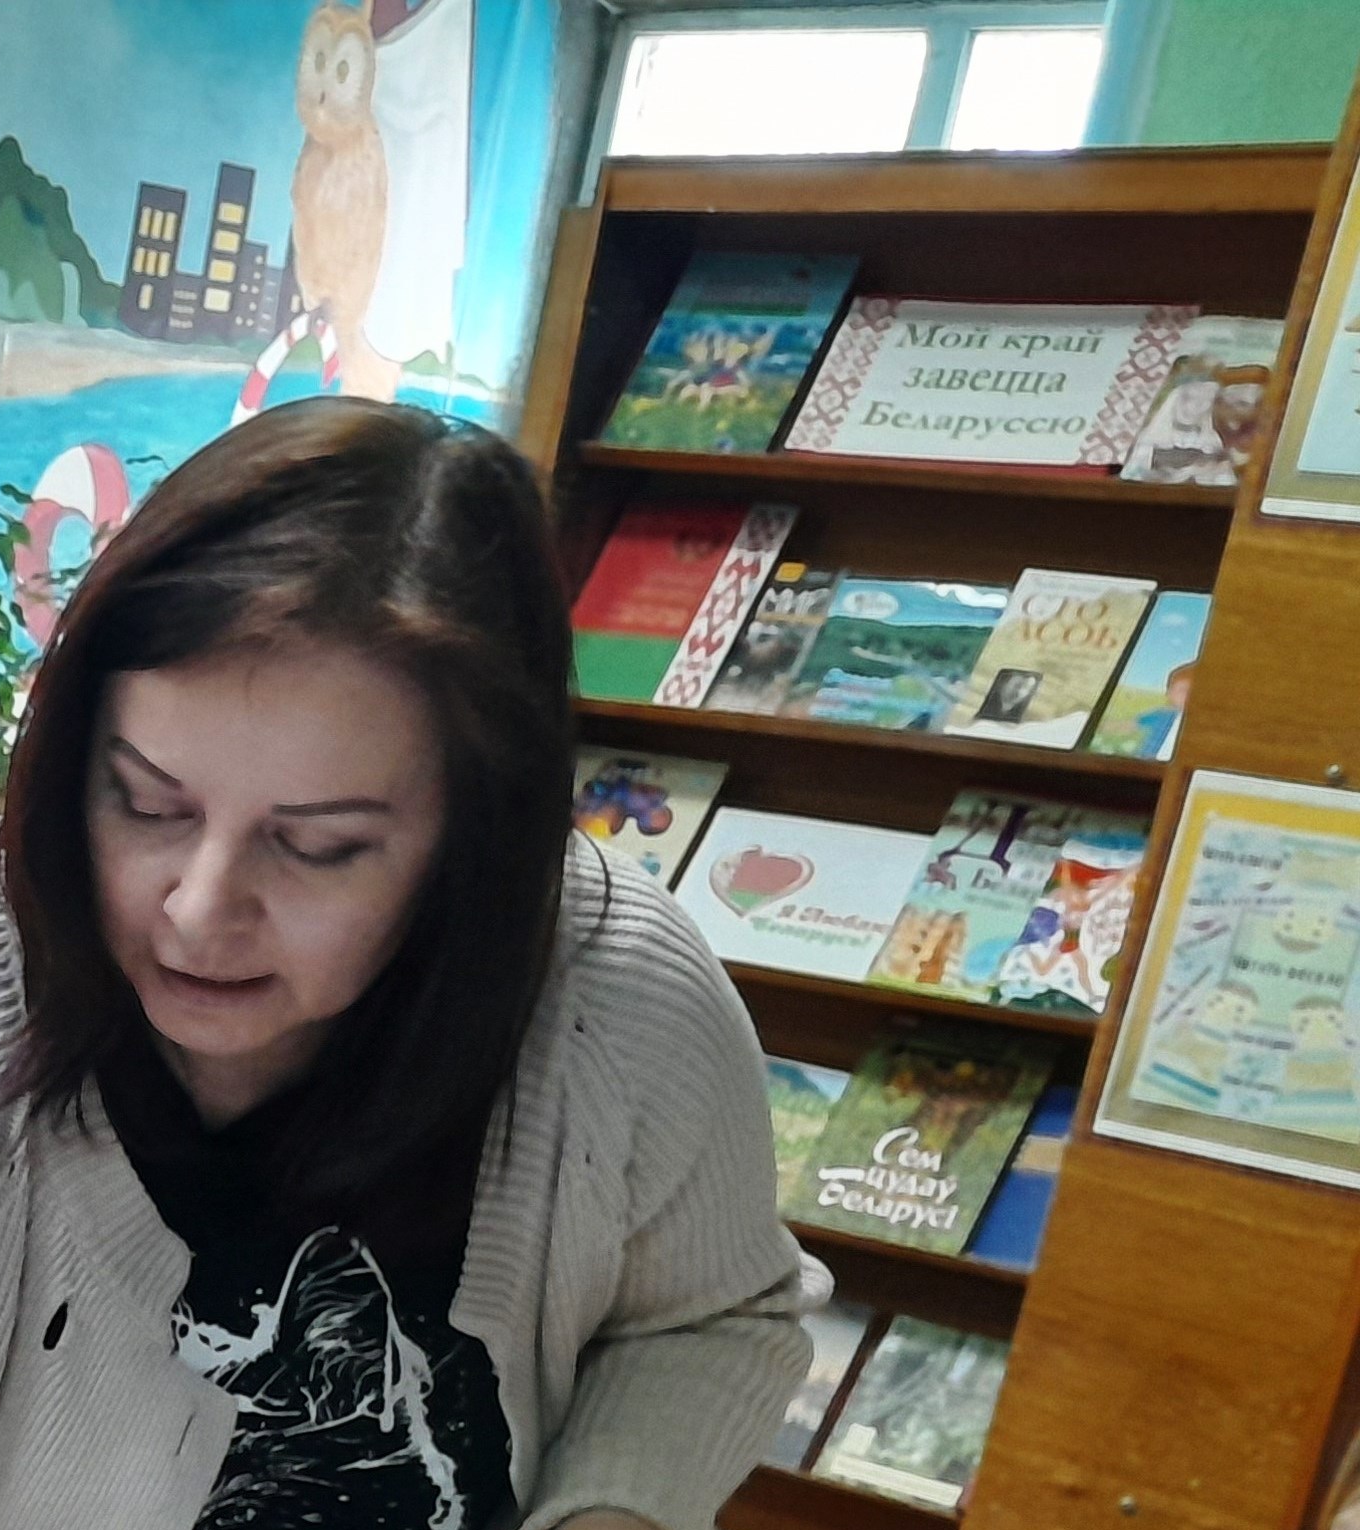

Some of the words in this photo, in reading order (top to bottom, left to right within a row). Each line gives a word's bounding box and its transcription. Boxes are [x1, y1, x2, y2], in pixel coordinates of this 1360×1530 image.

[895, 322, 990, 350] Мой
[1001, 328, 1104, 358] край
[902, 366, 1068, 395] завецца
[860, 400, 1087, 440] Беларуссю
